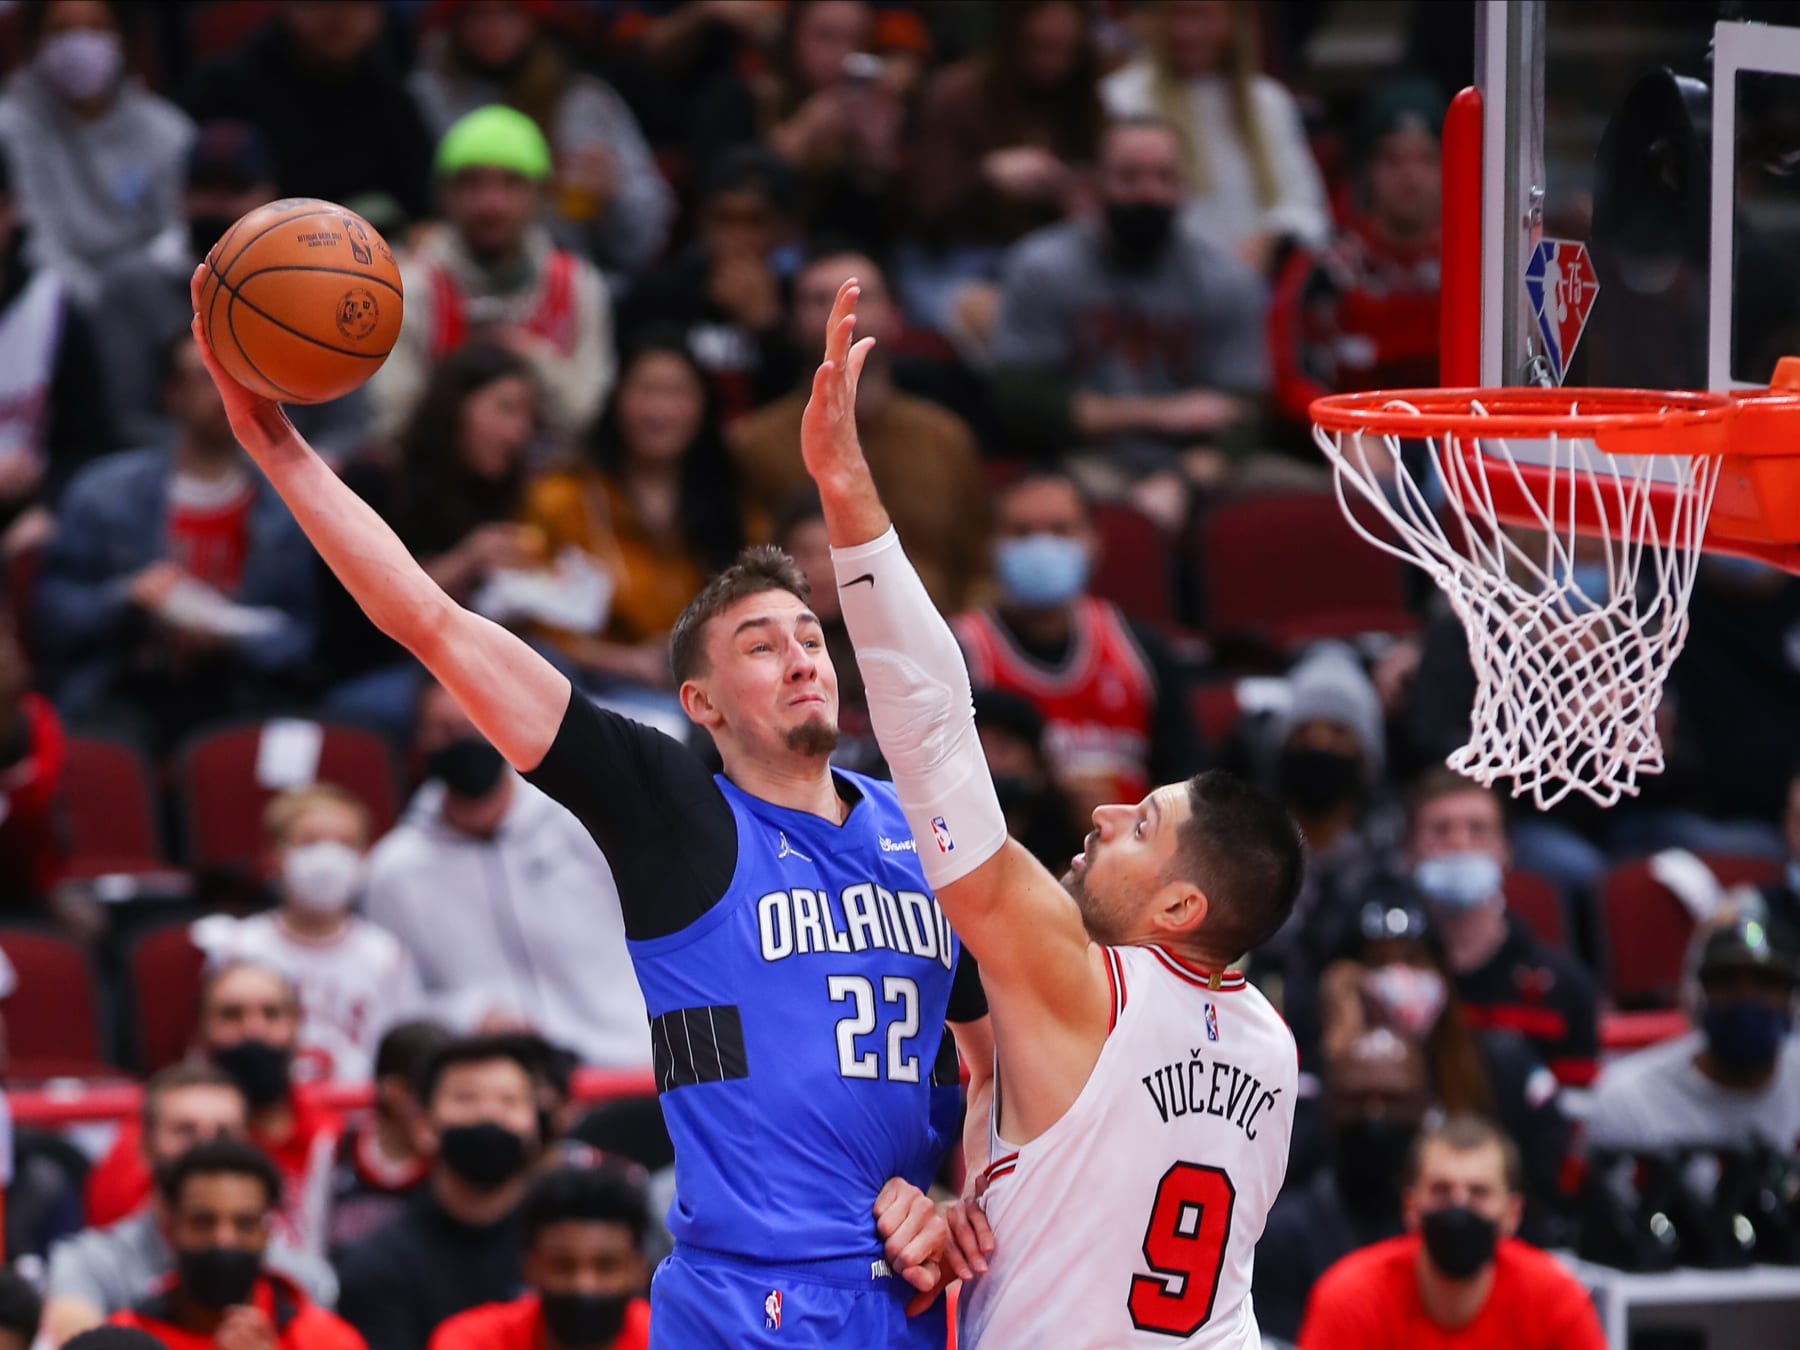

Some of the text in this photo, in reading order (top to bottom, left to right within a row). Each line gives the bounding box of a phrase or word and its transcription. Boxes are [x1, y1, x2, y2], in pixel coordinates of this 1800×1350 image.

[1567, 261, 1582, 304] 75
[757, 881, 953, 971] ORLANDO
[826, 974, 921, 1084] 22
[1142, 1048, 1282, 1142] VUČEVIĆ
[1127, 1160, 1236, 1338] 9
